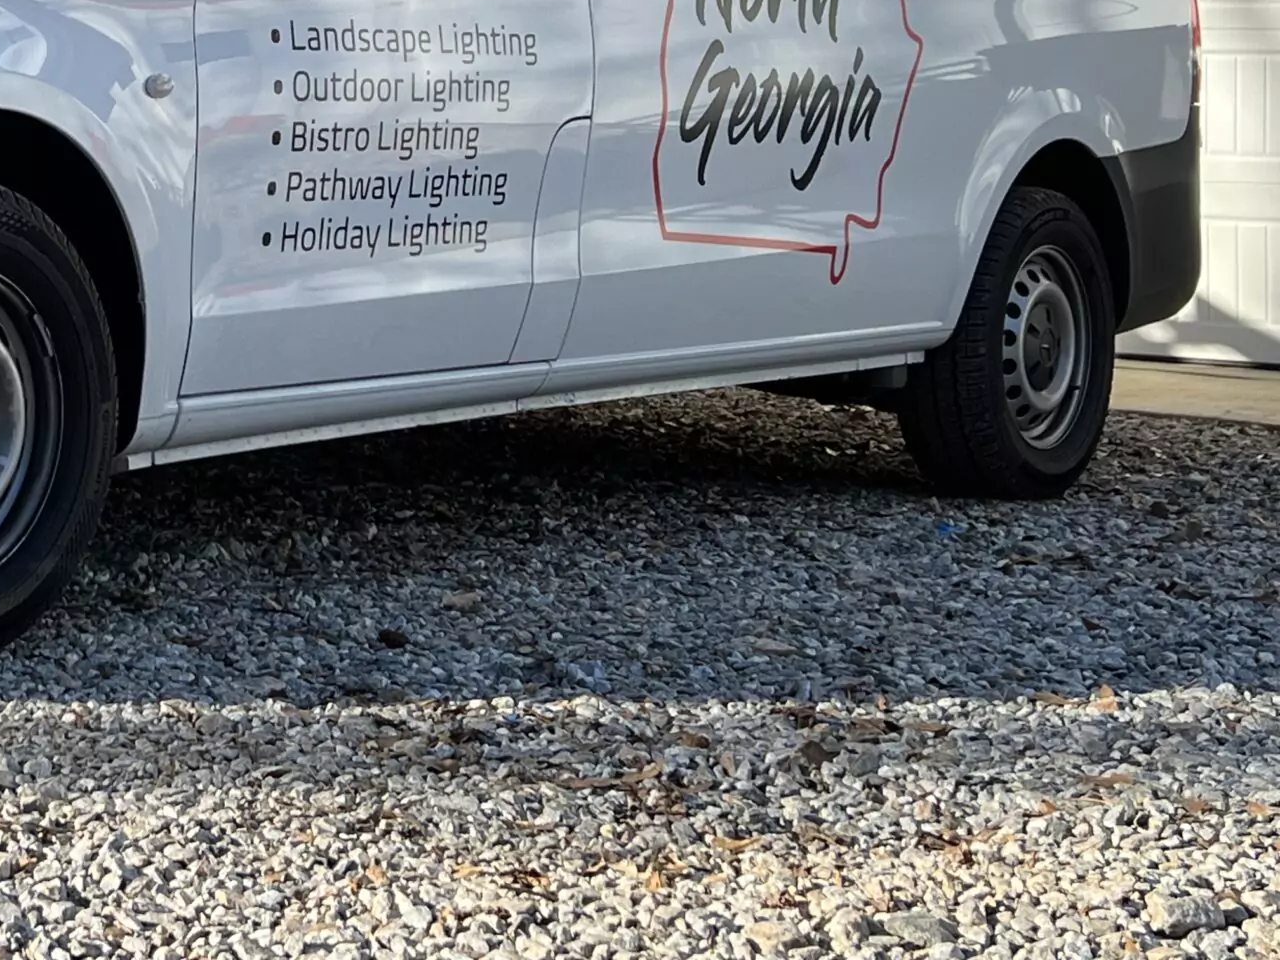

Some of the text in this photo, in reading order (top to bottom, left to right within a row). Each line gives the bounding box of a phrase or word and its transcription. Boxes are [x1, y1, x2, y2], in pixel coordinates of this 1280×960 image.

[290, 19, 538, 66] Landscape Lighting
[293, 68, 511, 112] Outdoor Lighting
[679, 39, 882, 191] Georgia
[290, 117, 480, 160] Bistro Lighting
[285, 165, 508, 208] Pathway Lighting
[280, 213, 488, 258] Holiday Lighting
